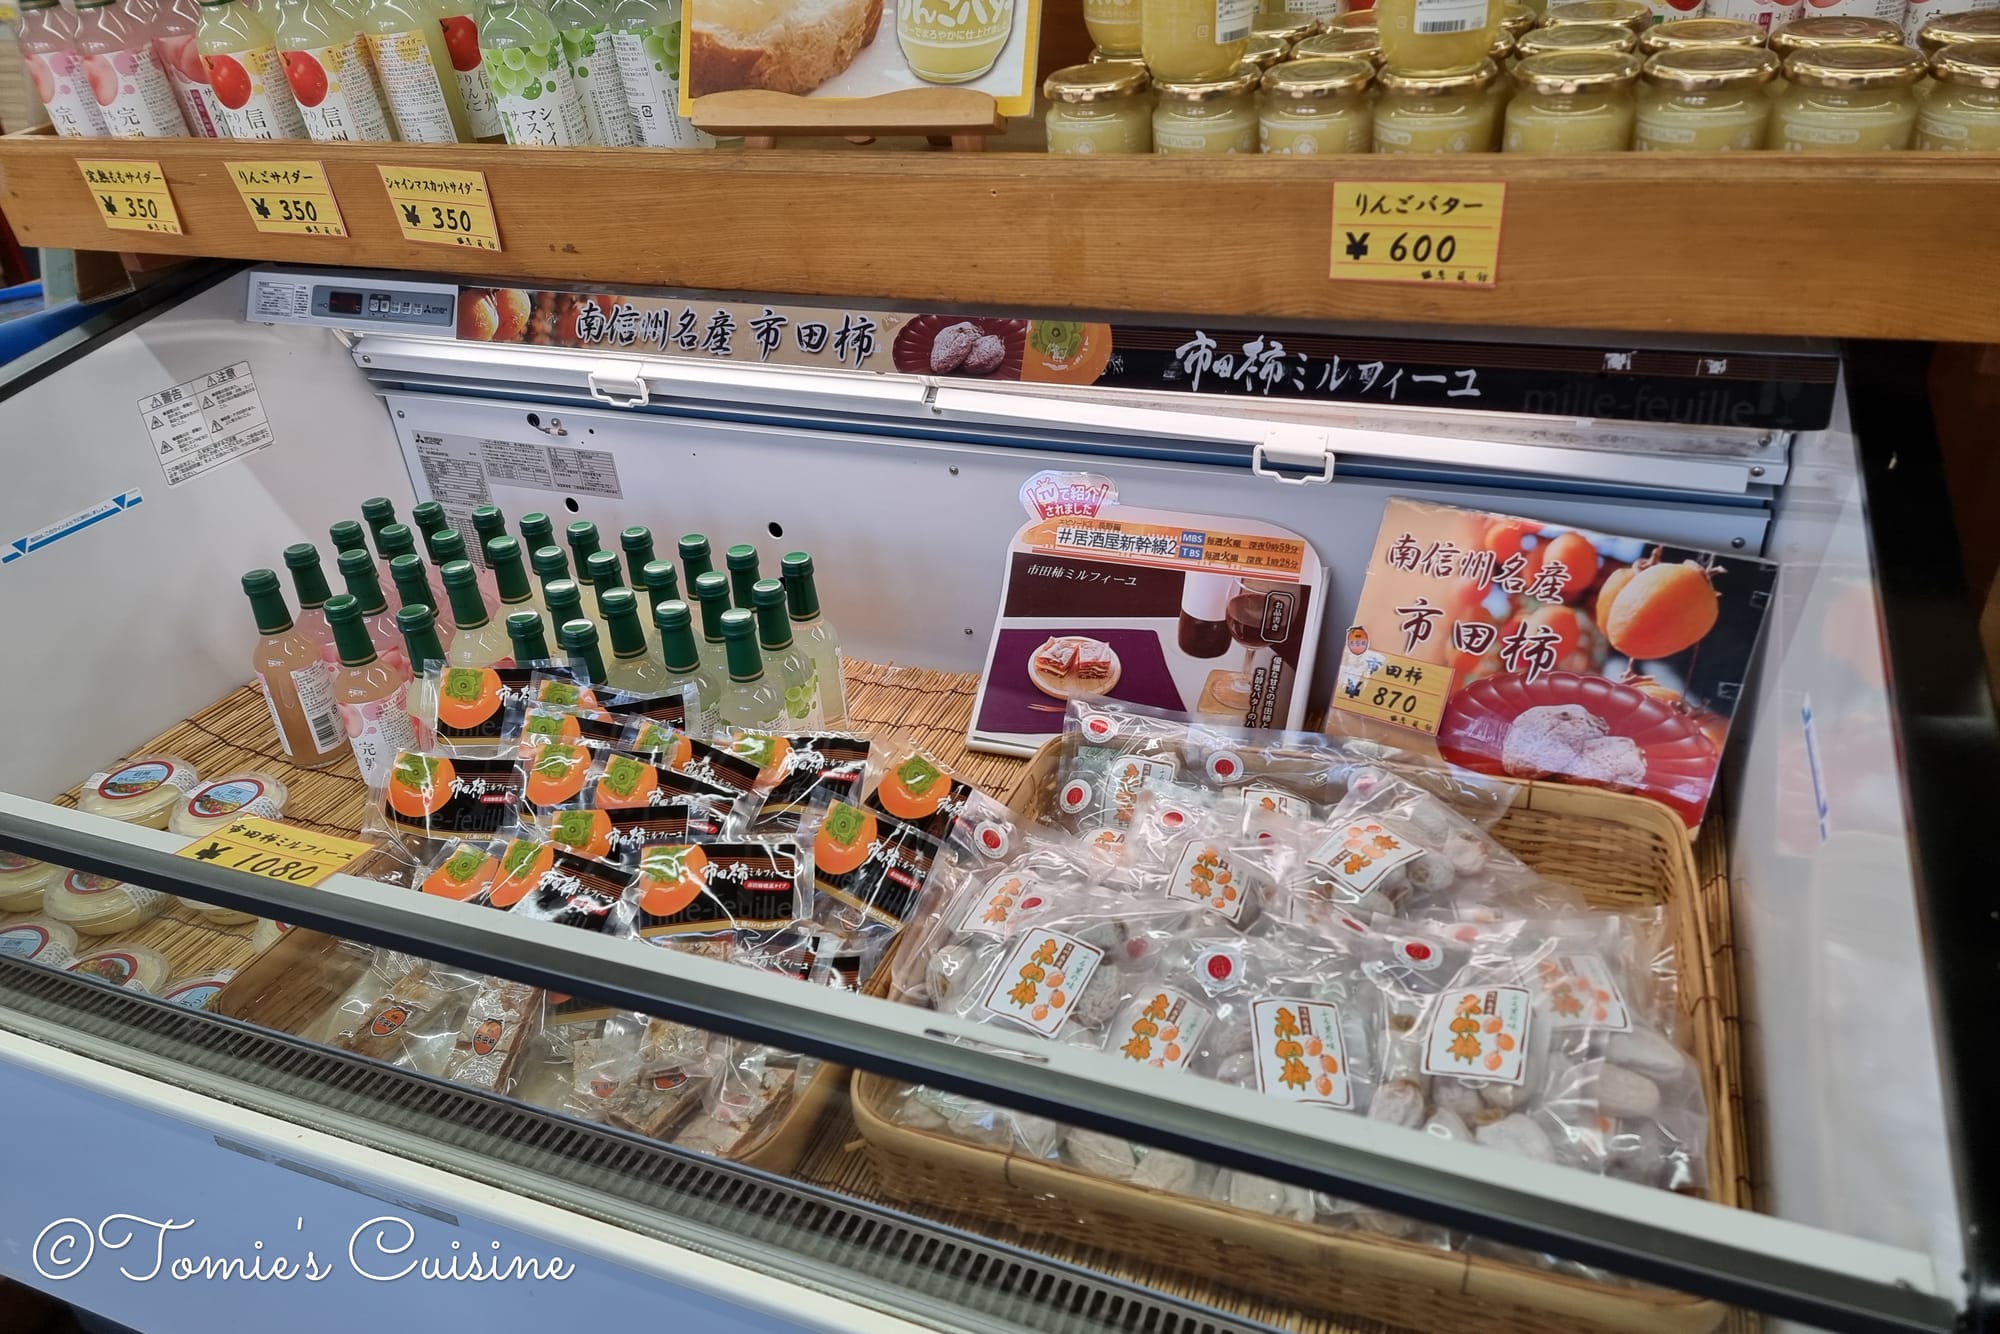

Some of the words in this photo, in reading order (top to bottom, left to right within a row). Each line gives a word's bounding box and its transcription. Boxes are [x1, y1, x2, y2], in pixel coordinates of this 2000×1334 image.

[85, 169, 162, 185] 完熟ももサイダー
[238, 169, 313, 186] りんごサイダー
[385, 177, 483, 195] シャインマスカットサイダー
[125, 197, 158, 219] 350
[280, 199, 318, 222] 350
[1355, 192, 1483, 216] りんごバター
[432, 207, 471, 232] 350
[1389, 231, 1457, 263] 600
[575, 301, 736, 356] 南信州名産
[749, 304, 877, 369] 市田柿
[215, 367, 238, 383] 注意
[1174, 330, 1480, 397] 市田柿ミルフィーユ
[160, 388, 185, 403] 警告
[1045, 503, 1093, 517] されました
[1058, 528, 1177, 555] #居酒屋新幹線2
[1182, 533, 1203, 543] MBS
[1206, 537, 1241, 548] 毎週火曜
[1182, 547, 1200, 558] TBS
[1205, 551, 1239, 562] 毎週火曜
[1027, 563, 1138, 586] 市田柿ミルフィーユ
[1388, 534, 1571, 602] 南信州名産
[1397, 599, 1562, 683] 市田柿
[1366, 657, 1423, 686] 市田柿
[1373, 687, 1417, 713] 870
[228, 824, 353, 861] 市田柿ミルフィーユ
[233, 853, 319, 881] 1080
